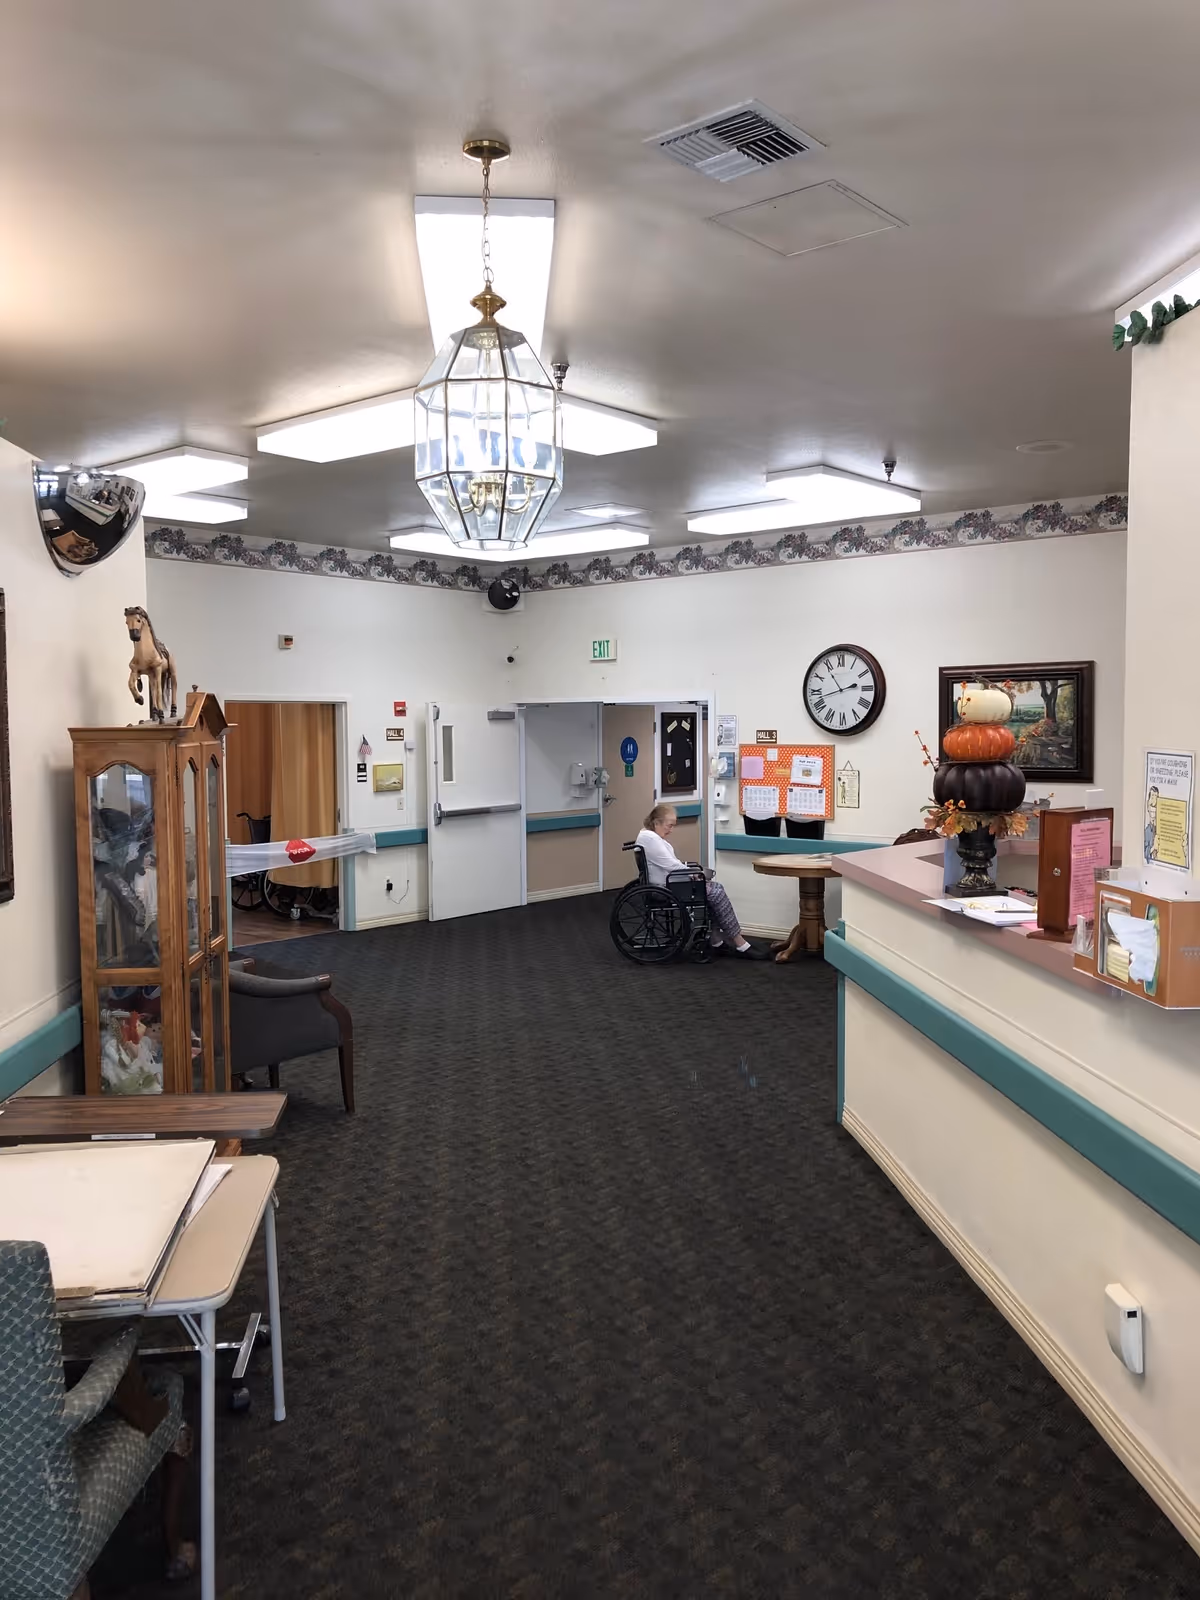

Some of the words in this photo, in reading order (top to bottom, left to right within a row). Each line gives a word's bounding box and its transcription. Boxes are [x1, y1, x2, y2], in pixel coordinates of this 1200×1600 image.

[592, 640, 610, 658] EXIT
[837, 654, 846, 668] XII
[387, 729, 399, 737] HALL
[757, 731, 770, 739] HALL
[771, 731, 777, 739] 3
